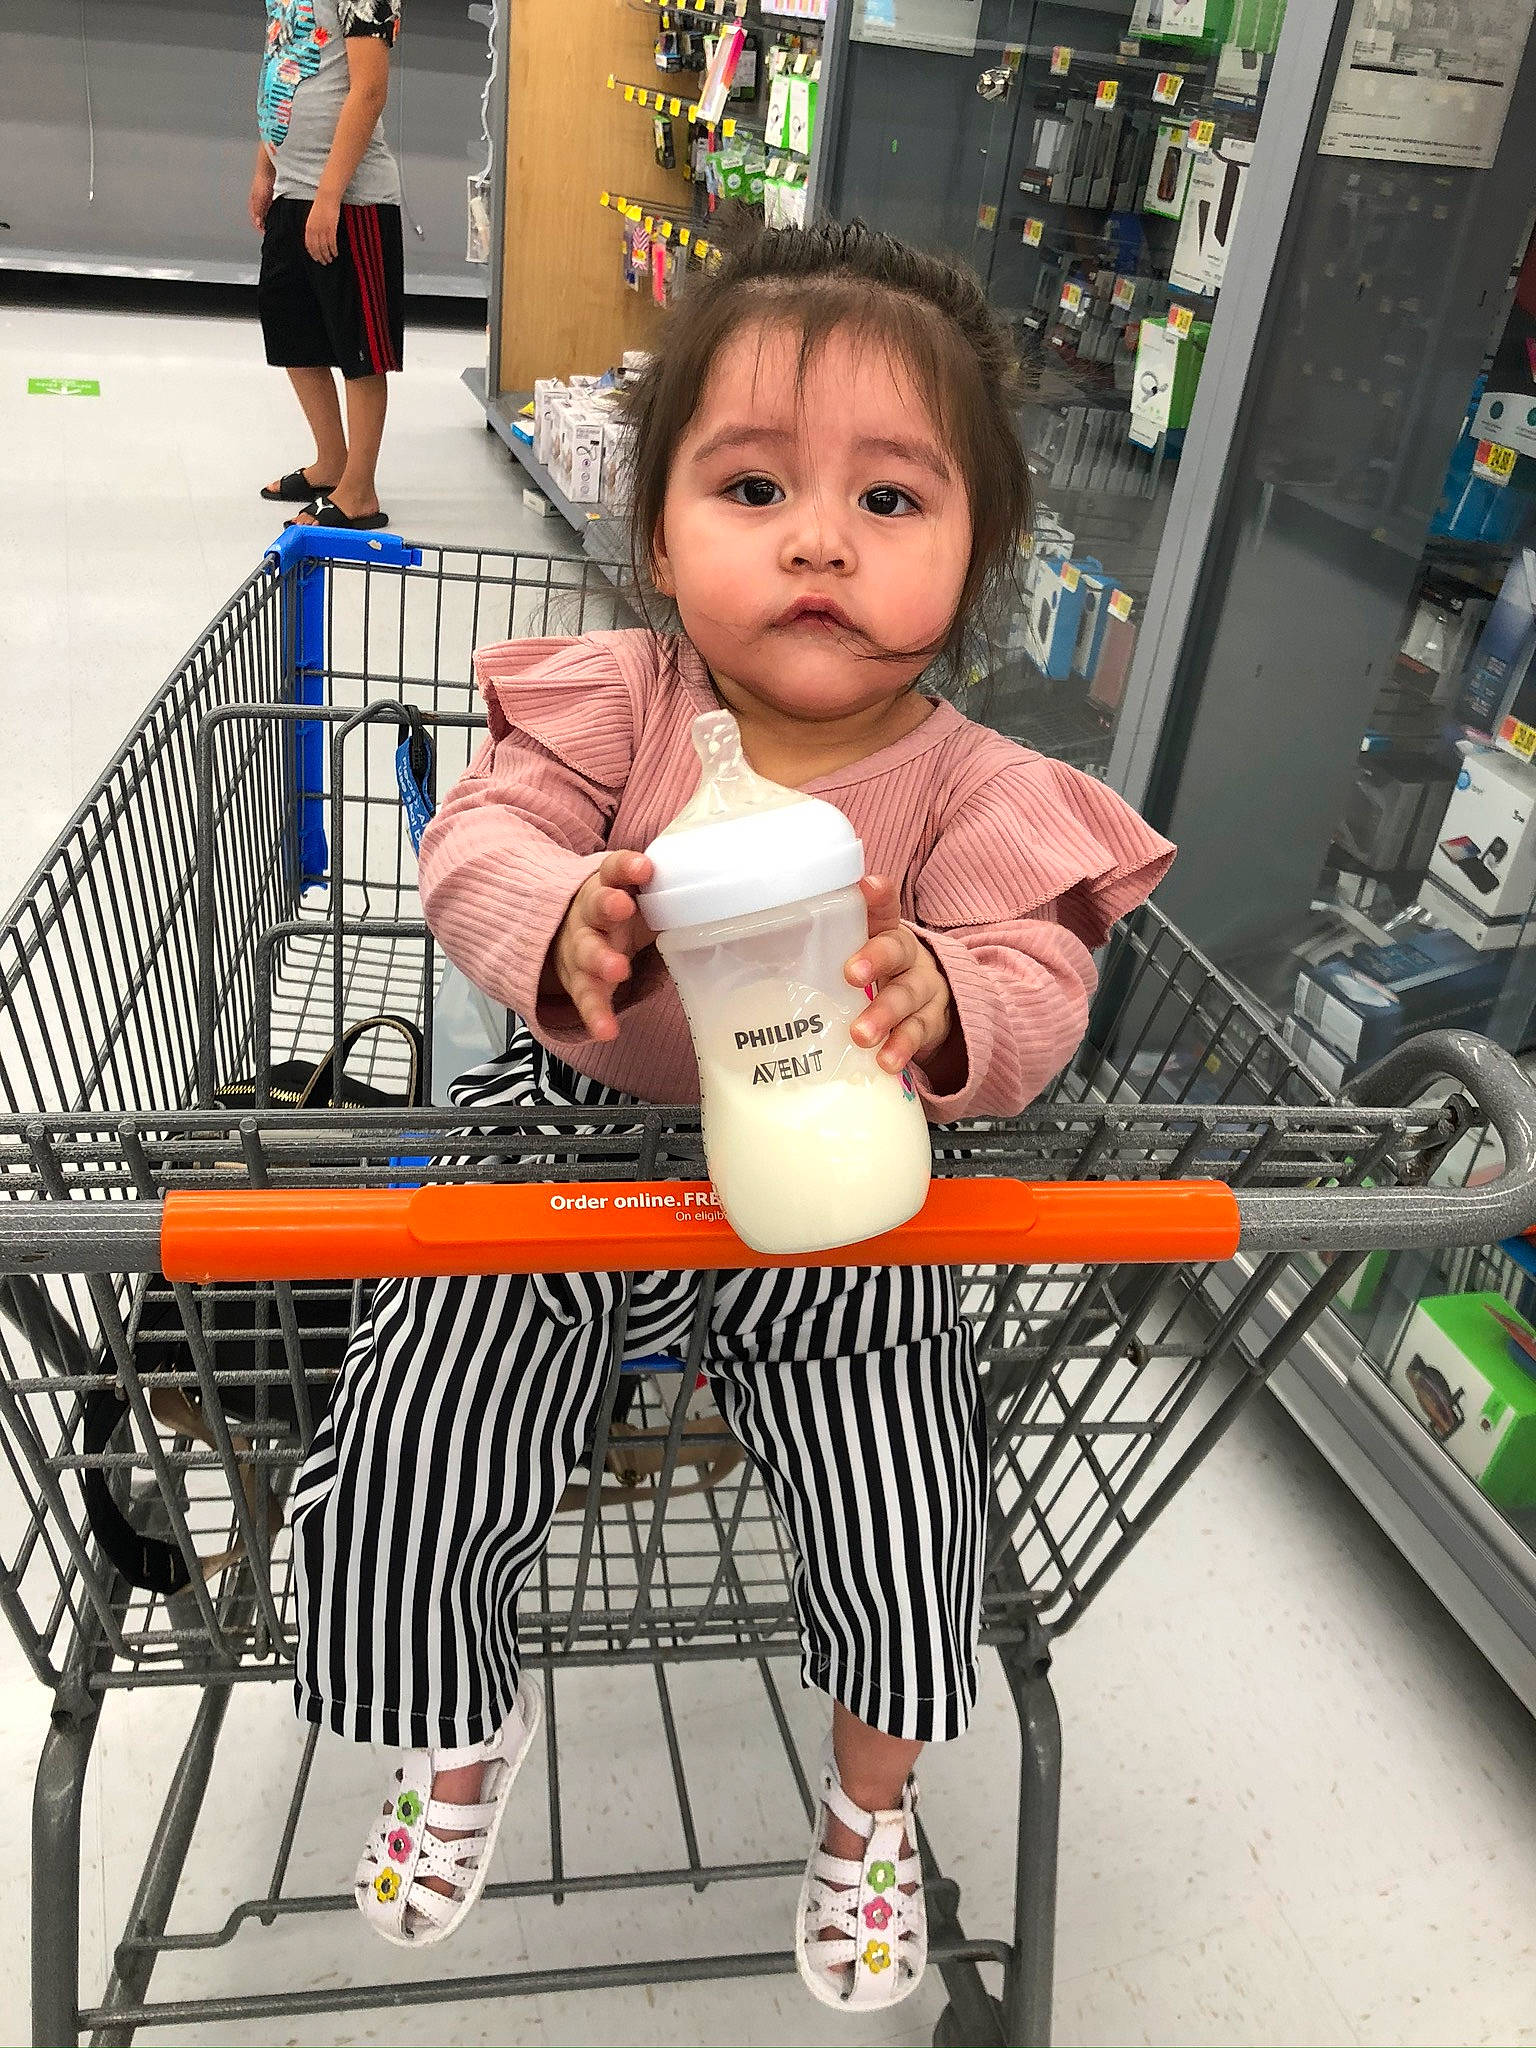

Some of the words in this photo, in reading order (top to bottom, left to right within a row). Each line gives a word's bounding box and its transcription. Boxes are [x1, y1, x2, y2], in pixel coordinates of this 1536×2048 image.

[734, 1014, 824, 1050] PHILIPS
[752, 1050, 823, 1085] AVENT
[550, 1195, 608, 1210] Order
[614, 1193, 681, 1209] online.
[684, 1192, 720, 1207] FRE
[675, 1211, 692, 1222] On
